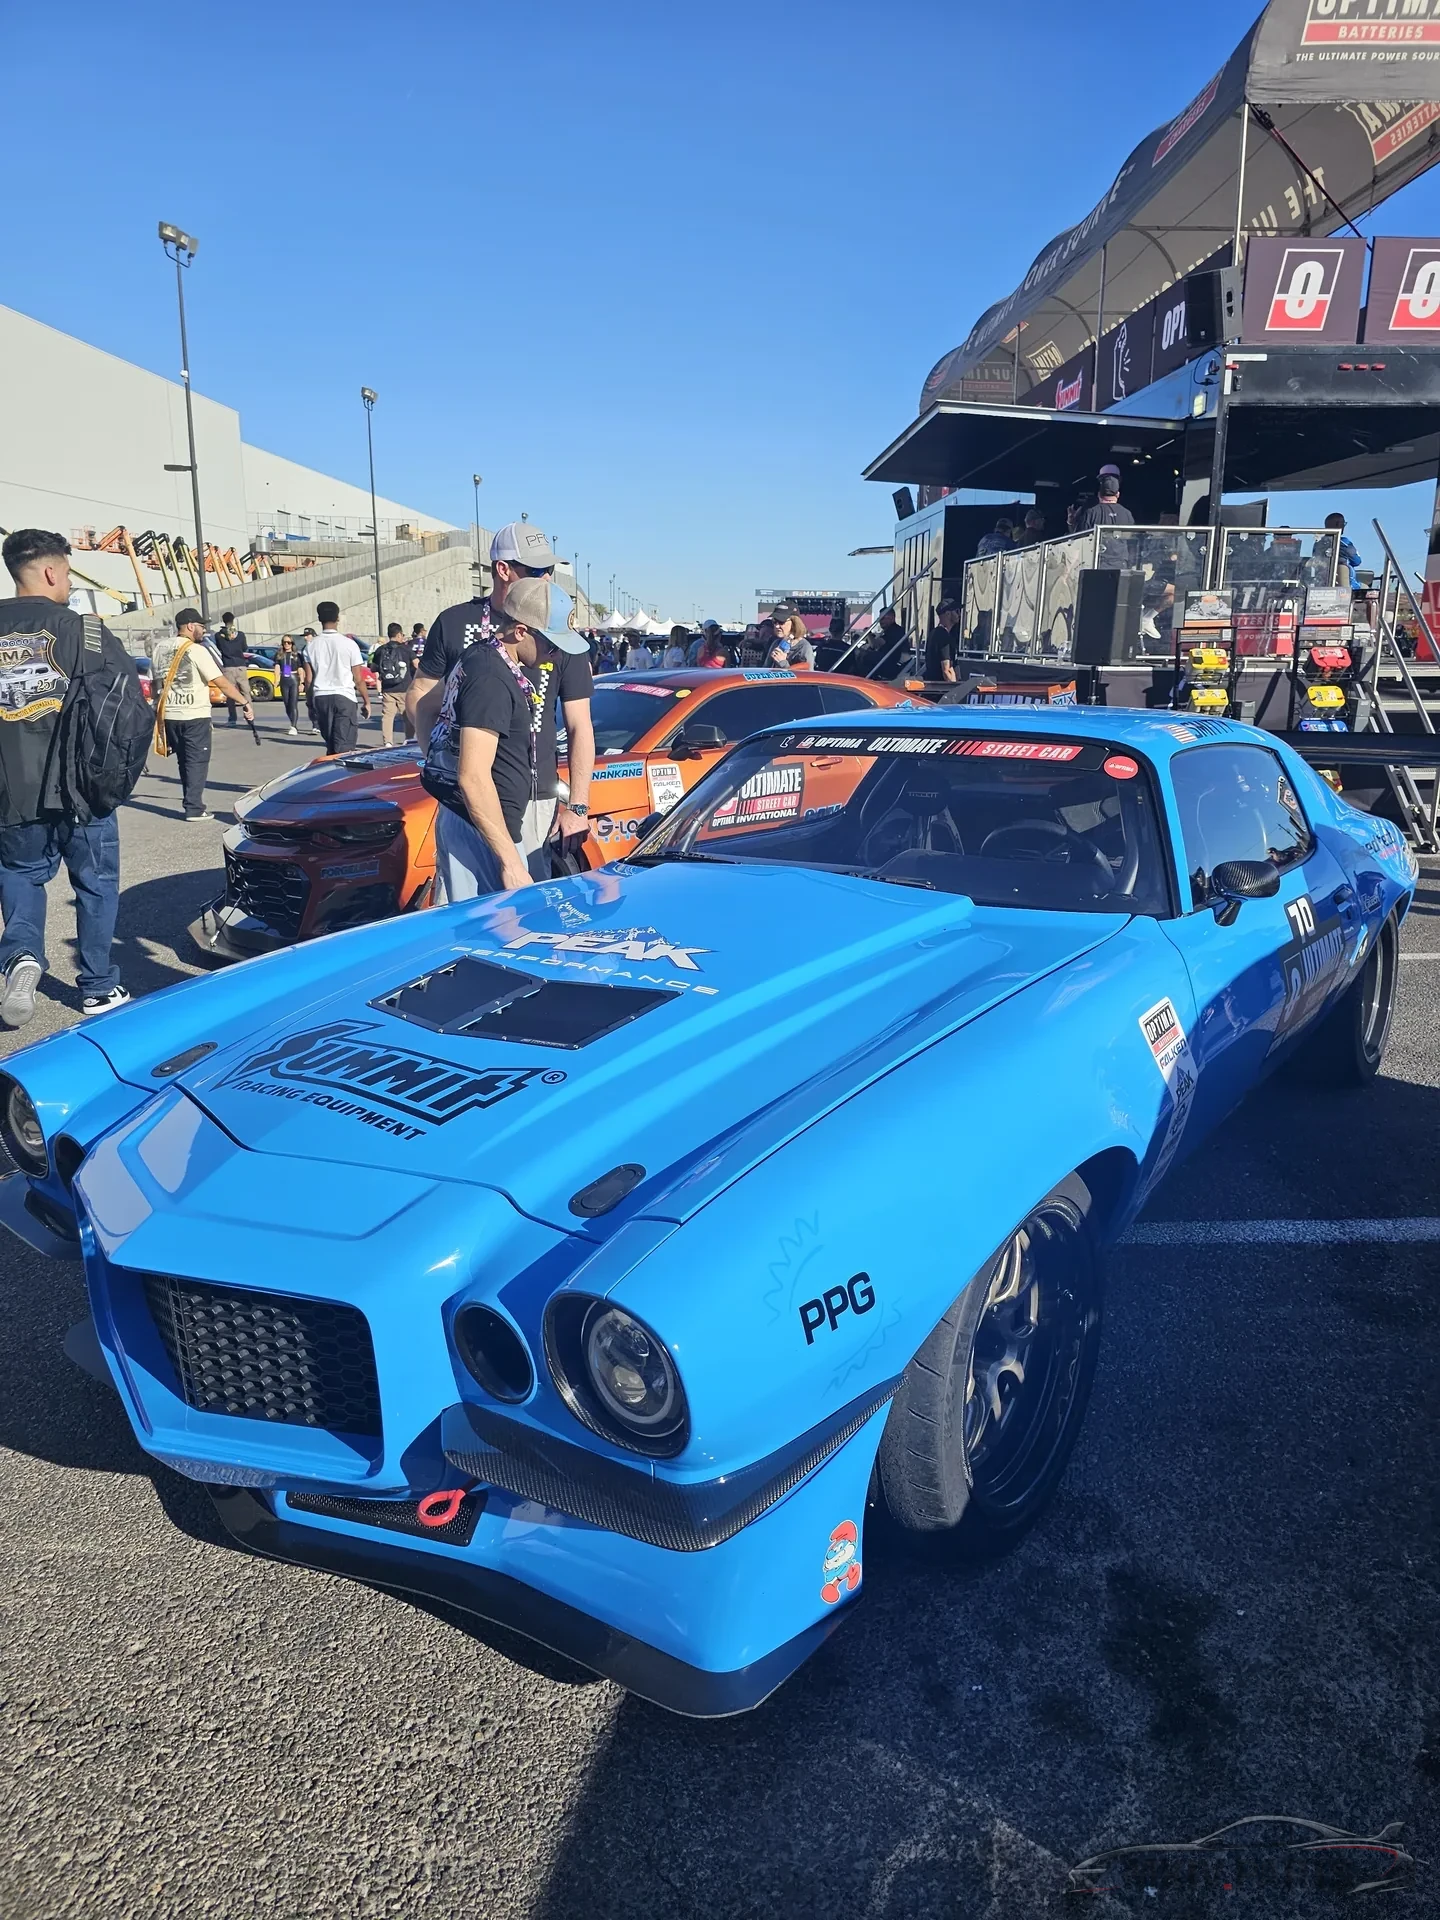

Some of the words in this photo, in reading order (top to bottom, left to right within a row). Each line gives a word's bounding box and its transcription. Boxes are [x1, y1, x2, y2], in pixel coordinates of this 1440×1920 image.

[1338, 25, 1424, 39] BATTERIES
[1296, 52, 1314, 61] THE
[1318, 52, 1367, 60] ULTIMATE
[1371, 52, 1407, 60] POWER
[1412, 52, 1440, 60] SOUR
[38, 678, 51, 692] 25
[814, 737, 865, 749] OPTIMA
[866, 737, 948, 754] ULTIMATE
[981, 743, 1037, 757] STREET
[1038, 746, 1075, 759] CAR
[592, 768, 643, 780] NANKANG
[652, 767, 677, 777] OPTIMA
[741, 768, 802, 799] ULTIMATE
[658, 792, 679, 802] PEAK
[757, 797, 781, 811] STREET
[783, 795, 797, 807] CAR
[712, 815, 735, 827] OPTIMA
[736, 808, 798, 824] INVITATIONAL
[1287, 897, 1316, 944] 70
[503, 931, 720, 972] PEAK
[450, 946, 720, 996] PERFORMANCE
[1146, 1008, 1174, 1042] OPTIMA
[1160, 1038, 1187, 1069] FALKEN
[218, 1020, 540, 1120] SUMMIT
[1175, 1069, 1195, 1103] PEAK
[232, 1080, 307, 1100] RACING
[304, 1092, 427, 1141] EQUIPMENT
[798, 1271, 877, 1346] PPG
